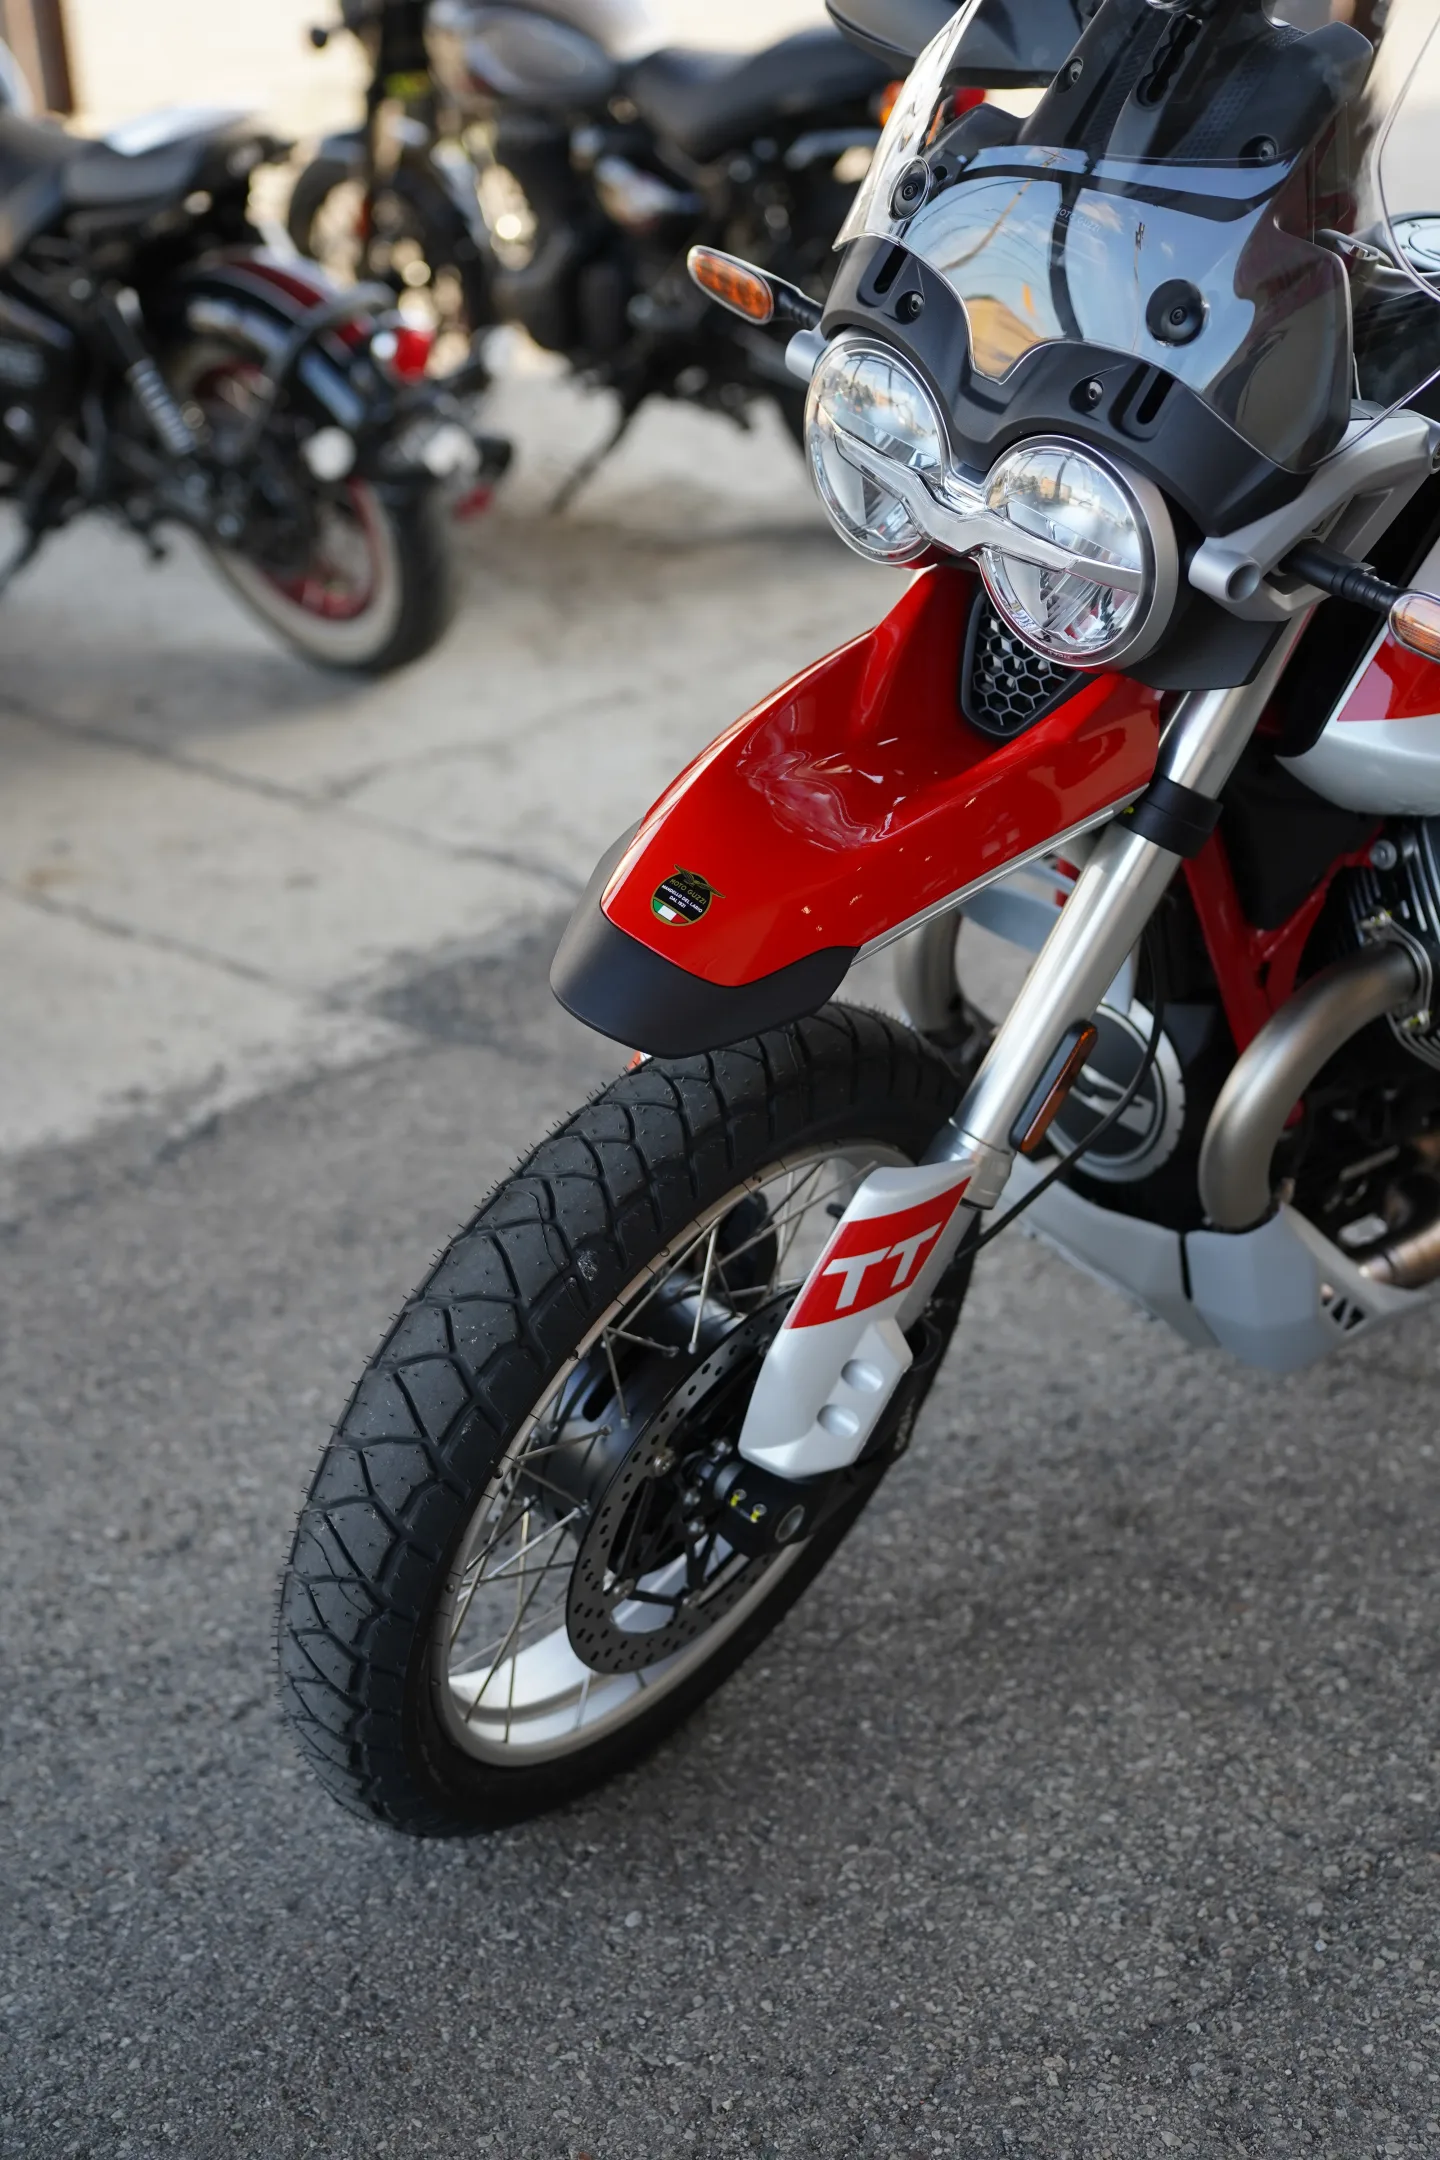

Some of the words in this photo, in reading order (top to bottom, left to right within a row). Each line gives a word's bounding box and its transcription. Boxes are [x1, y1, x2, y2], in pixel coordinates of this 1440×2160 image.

[669, 895, 677, 903] DAL
[670, 879, 687, 890] MOTO
[687, 890, 707, 905] GUZZI
[822, 1221, 942, 1310] TT
